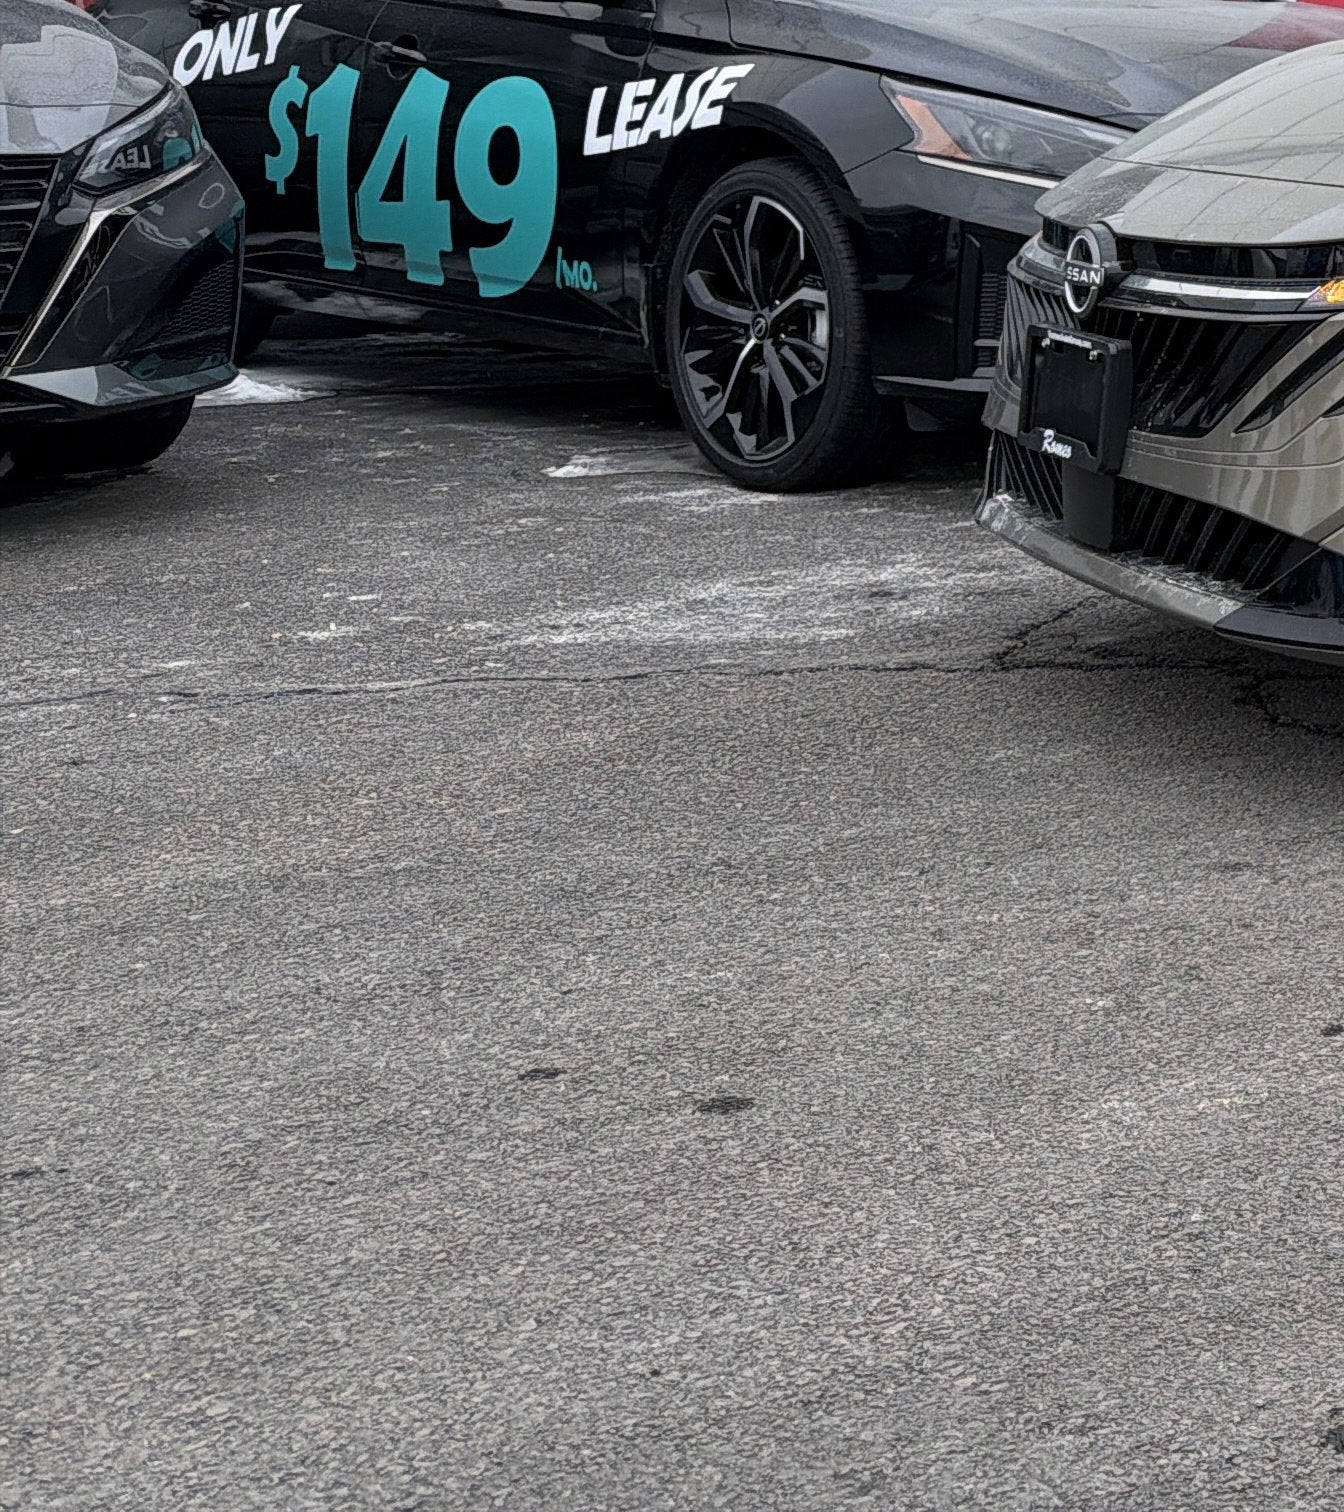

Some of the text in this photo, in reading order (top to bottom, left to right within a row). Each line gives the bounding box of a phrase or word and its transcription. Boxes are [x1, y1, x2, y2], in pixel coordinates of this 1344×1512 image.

[173, 4, 303, 86] ONLY
[583, 63, 759, 156] LEASE
[265, 63, 558, 298] $149
